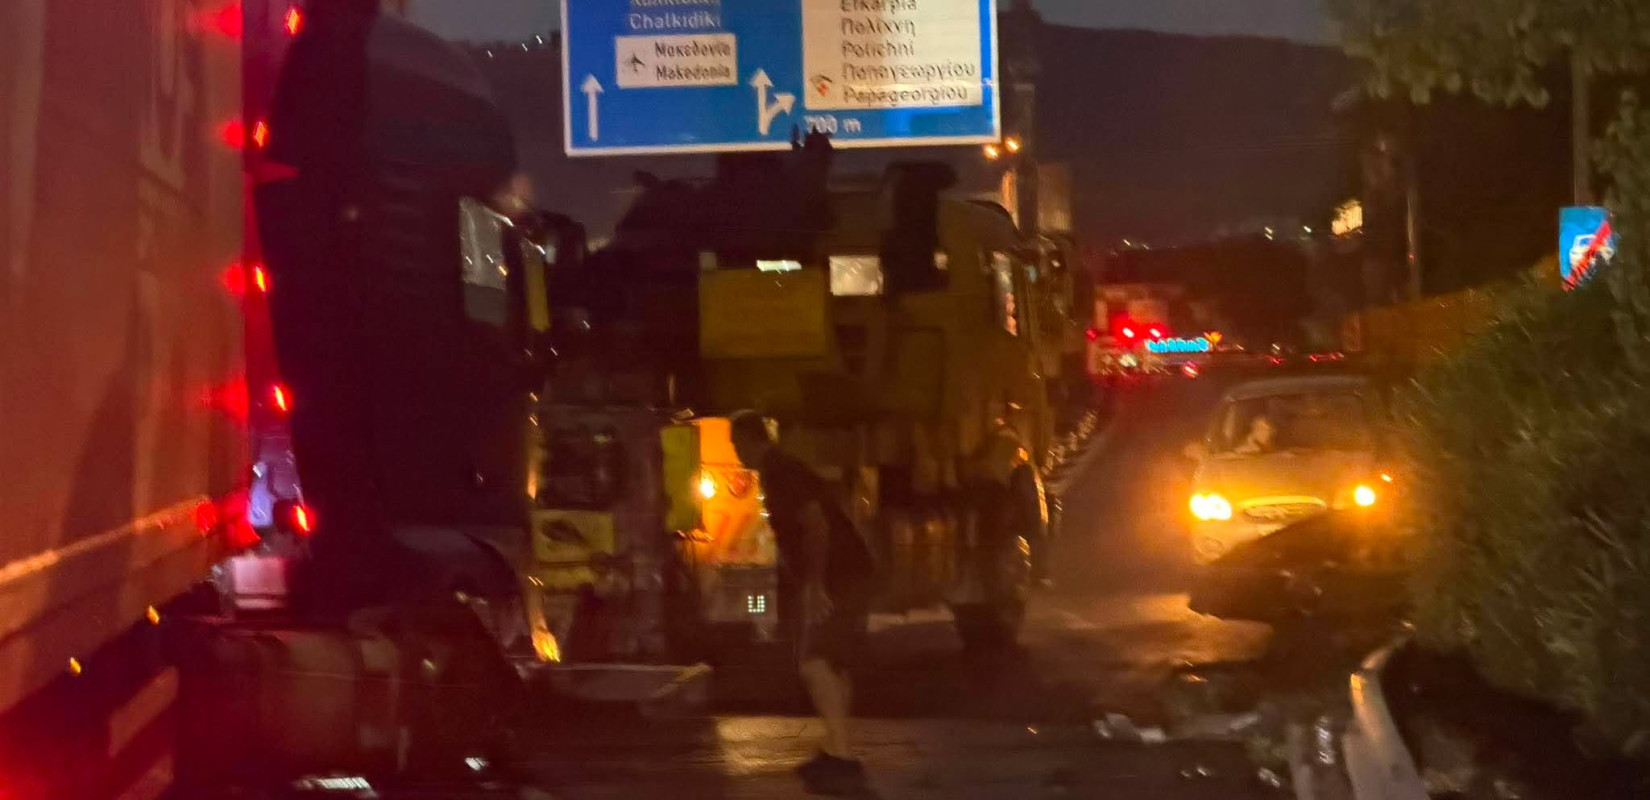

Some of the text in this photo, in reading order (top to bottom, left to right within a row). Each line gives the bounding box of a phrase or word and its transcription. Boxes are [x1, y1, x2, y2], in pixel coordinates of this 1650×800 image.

[629, 11, 721, 29] Chalkidiki
[842, 39, 915, 58] Polichni
[843, 86, 968, 107] Papageorgiou
[803, 115, 862, 134] 700 m
